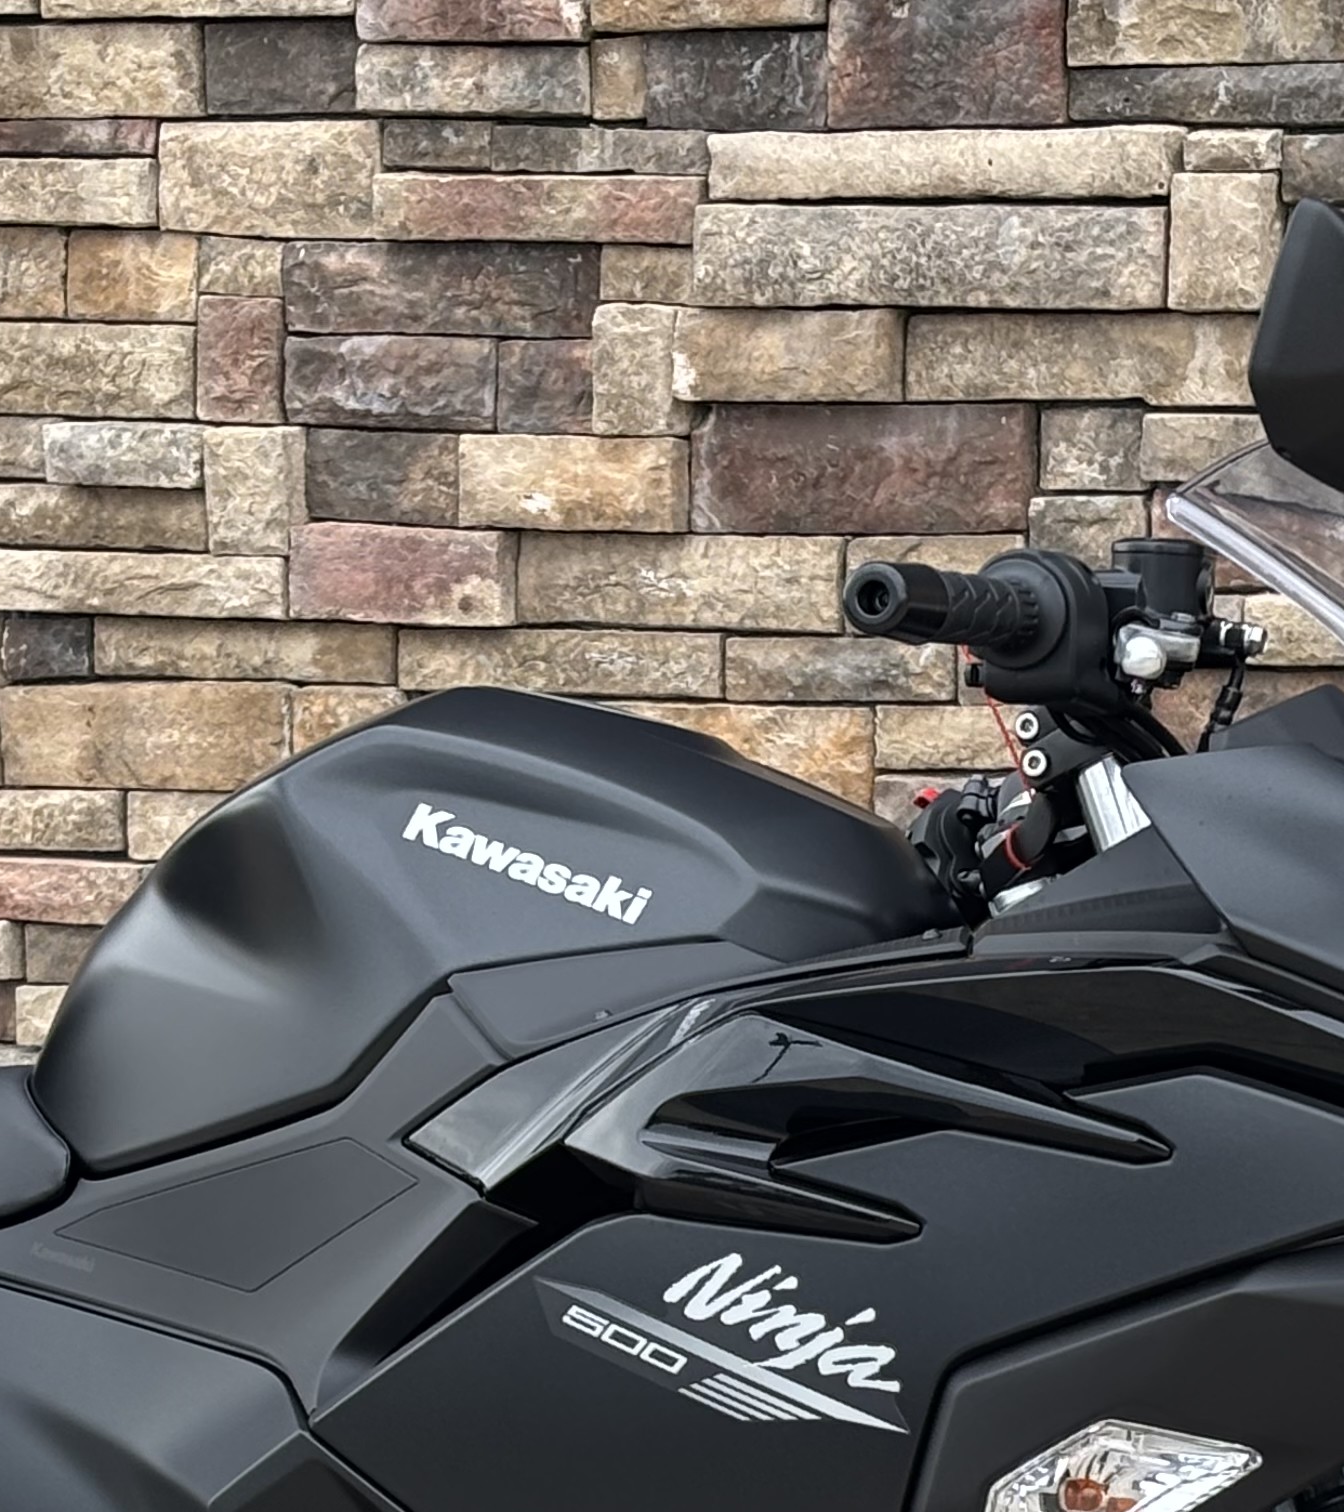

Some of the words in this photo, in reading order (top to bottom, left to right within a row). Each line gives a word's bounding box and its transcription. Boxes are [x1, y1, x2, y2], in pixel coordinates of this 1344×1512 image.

[402, 802, 653, 925] Kawasaki
[561, 1304, 688, 1375] 500
[662, 1252, 901, 1393] Ninja
